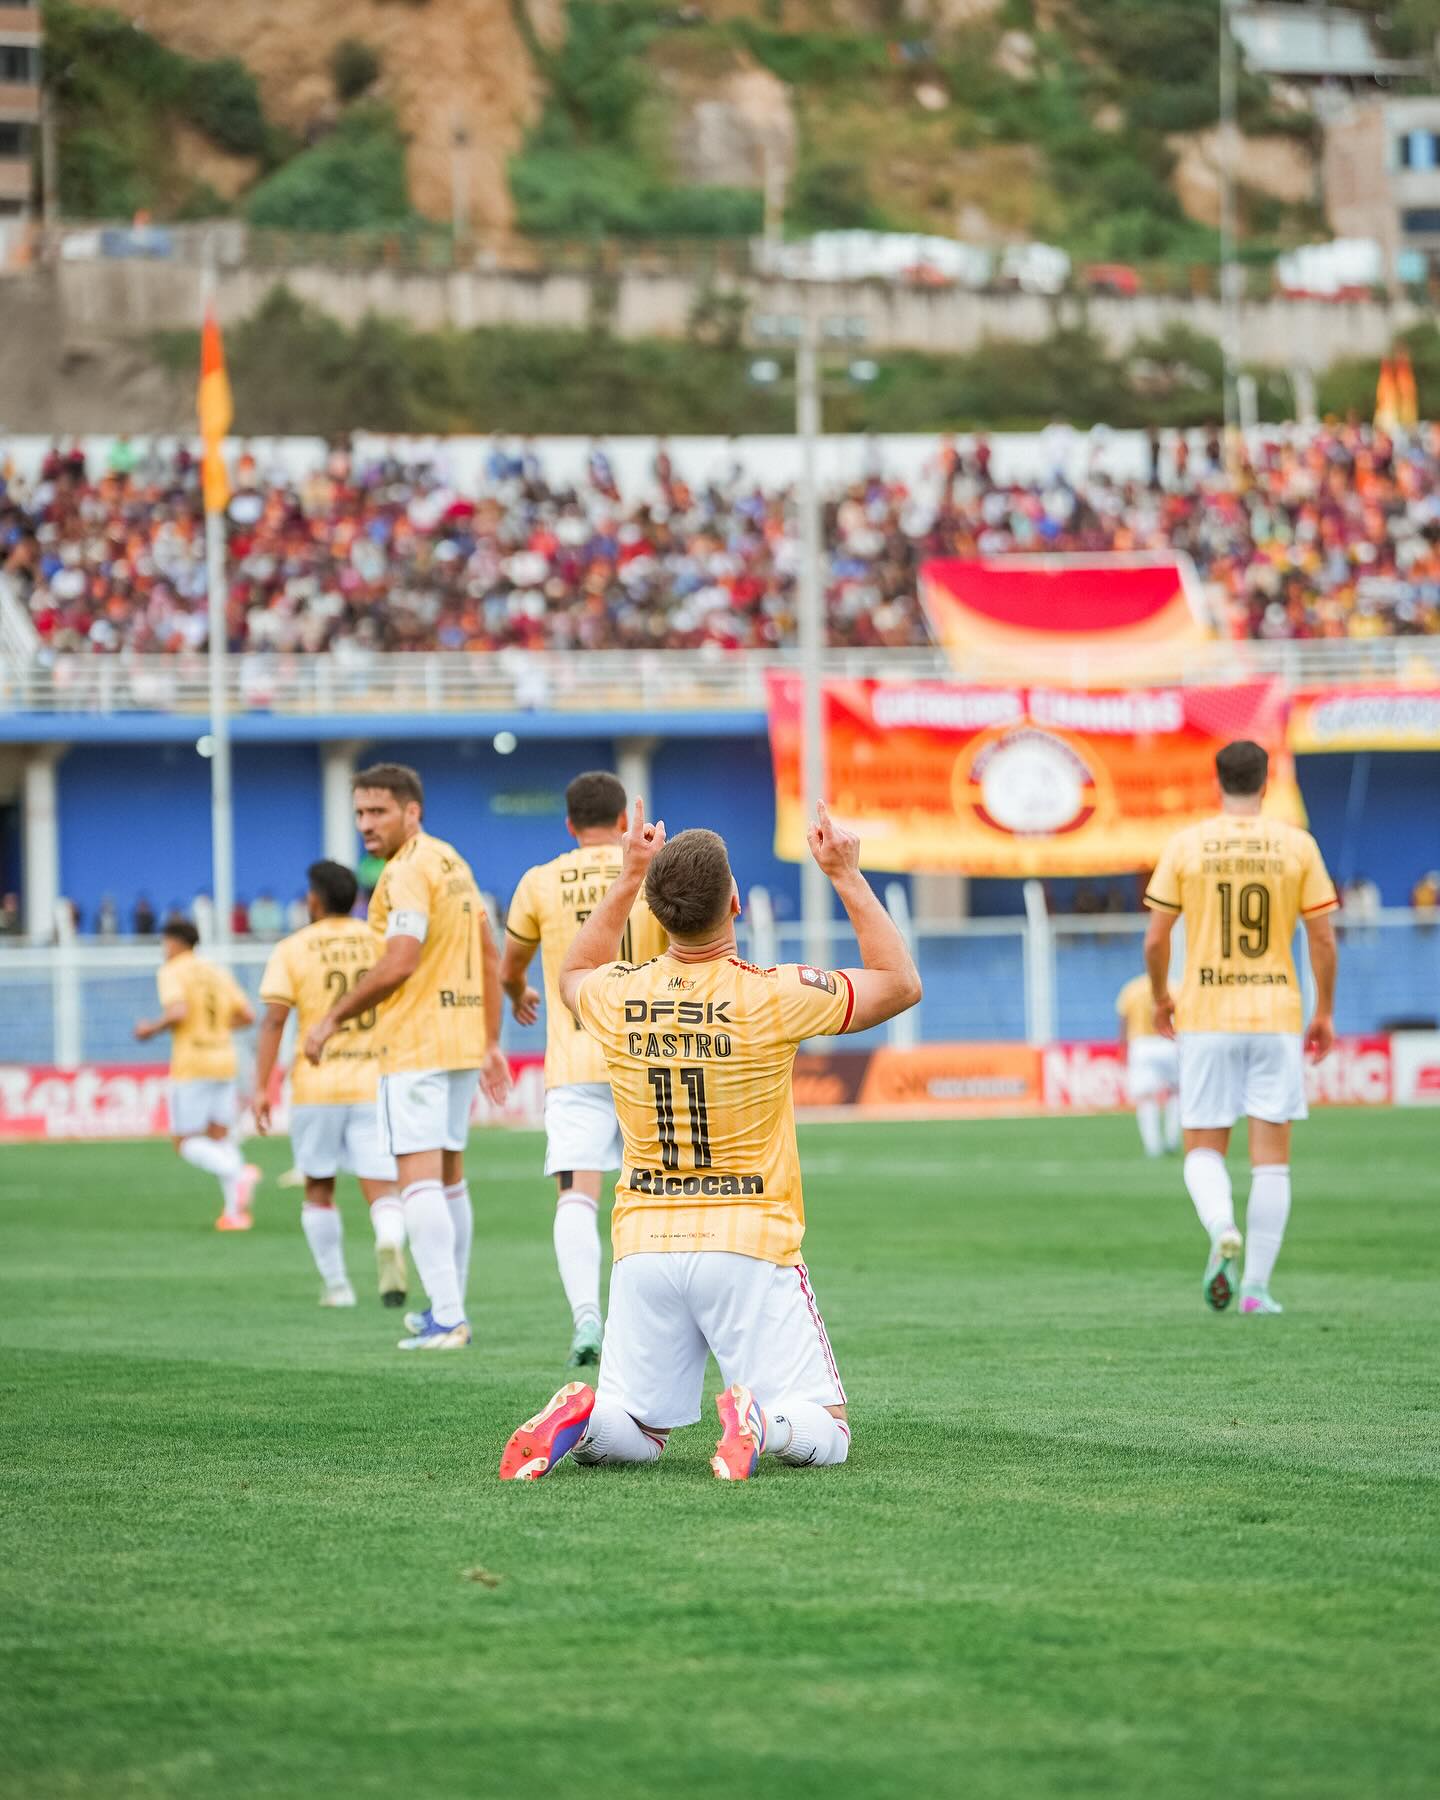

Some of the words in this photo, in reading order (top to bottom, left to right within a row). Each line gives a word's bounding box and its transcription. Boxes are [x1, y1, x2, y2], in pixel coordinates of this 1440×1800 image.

[560, 866, 622, 883] DFS
[1217, 882, 1270, 959] 19
[1200, 967, 1288, 986] Ricocan
[624, 1000, 732, 1024] DFSK
[628, 1031, 732, 1058] CASTRO
[647, 1067, 713, 1171] 11
[629, 1168, 764, 1196] Ricocan
